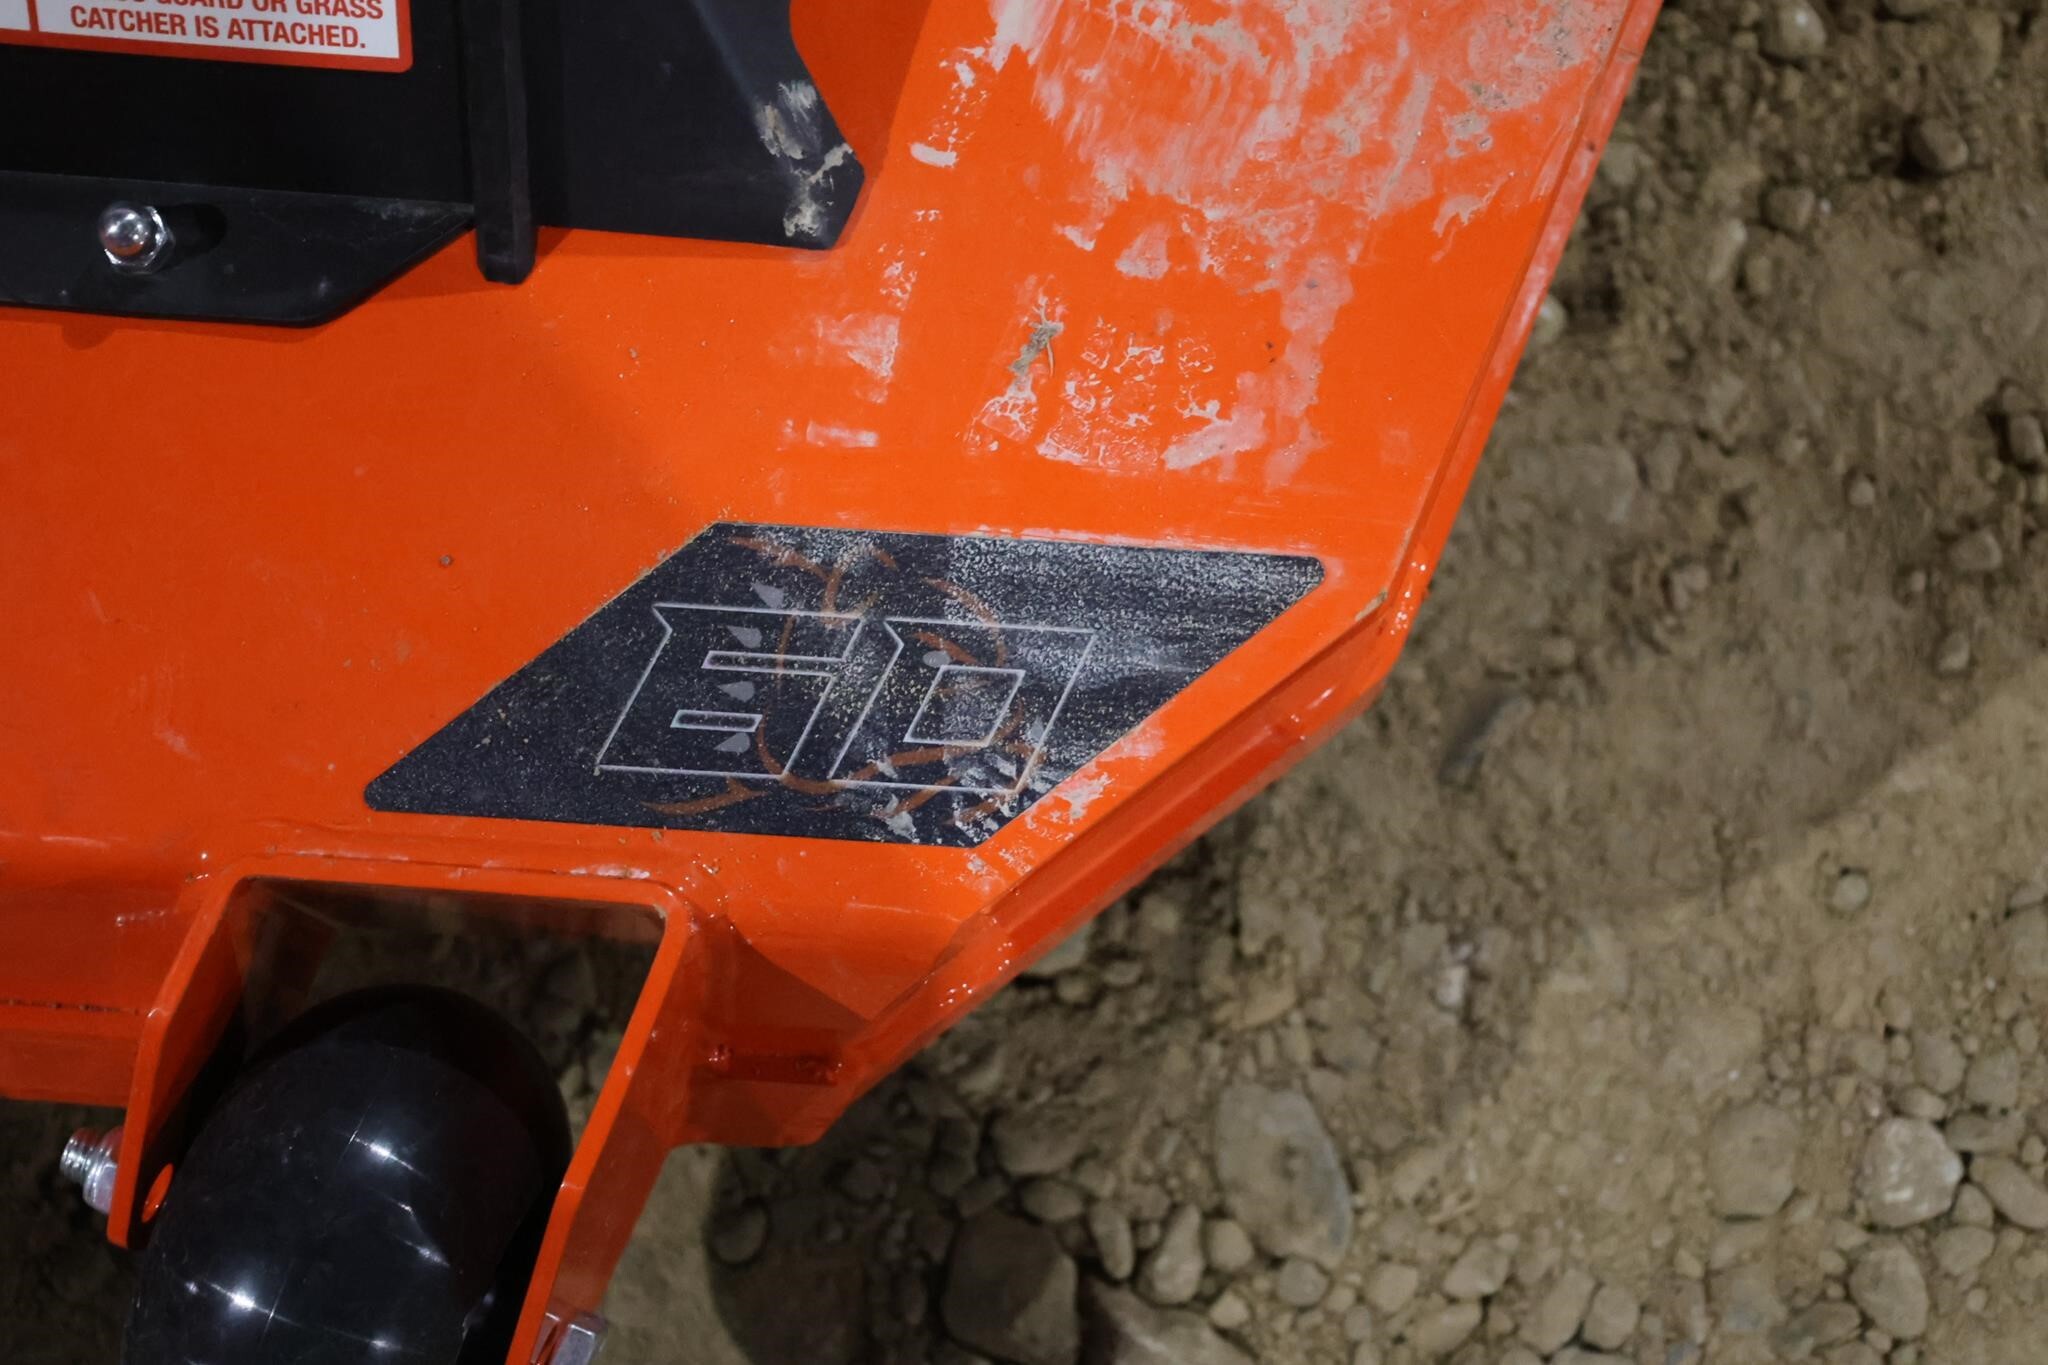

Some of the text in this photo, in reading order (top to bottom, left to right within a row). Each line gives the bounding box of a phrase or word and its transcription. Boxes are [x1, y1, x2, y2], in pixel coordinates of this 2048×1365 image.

[296, 0, 384, 19] GRASS
[70, 5, 366, 48] CATCHER IS ATTACHED.
